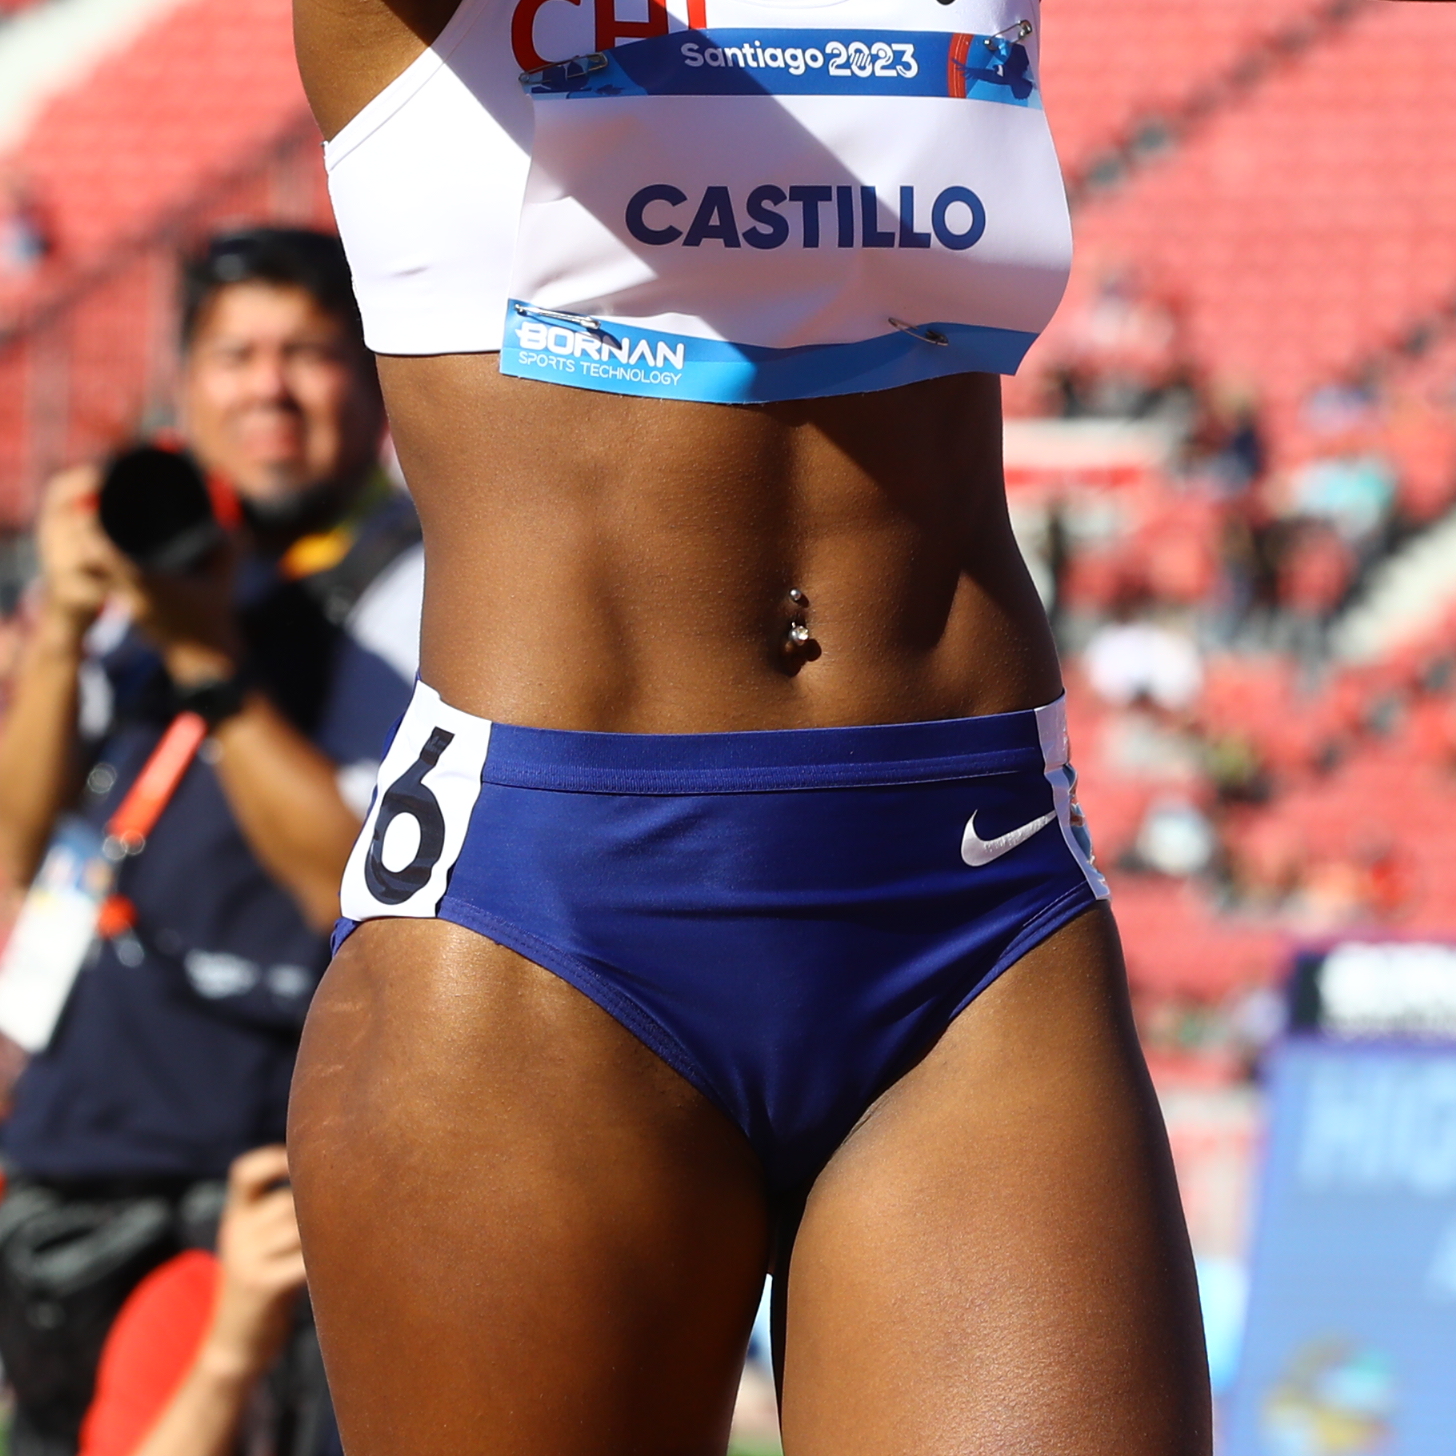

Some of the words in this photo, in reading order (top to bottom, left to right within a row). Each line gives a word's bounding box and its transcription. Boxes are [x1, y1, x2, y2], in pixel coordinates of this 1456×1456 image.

[680, 40, 824, 76] Santiago
[825, 41, 919, 79] 2023
[624, 184, 987, 250] CASTILLO
[515, 321, 685, 370] BORNAN
[518, 351, 576, 373] SPORTS
[580, 361, 682, 386] TECHNOLOGY
[365, 726, 455, 905] 6
